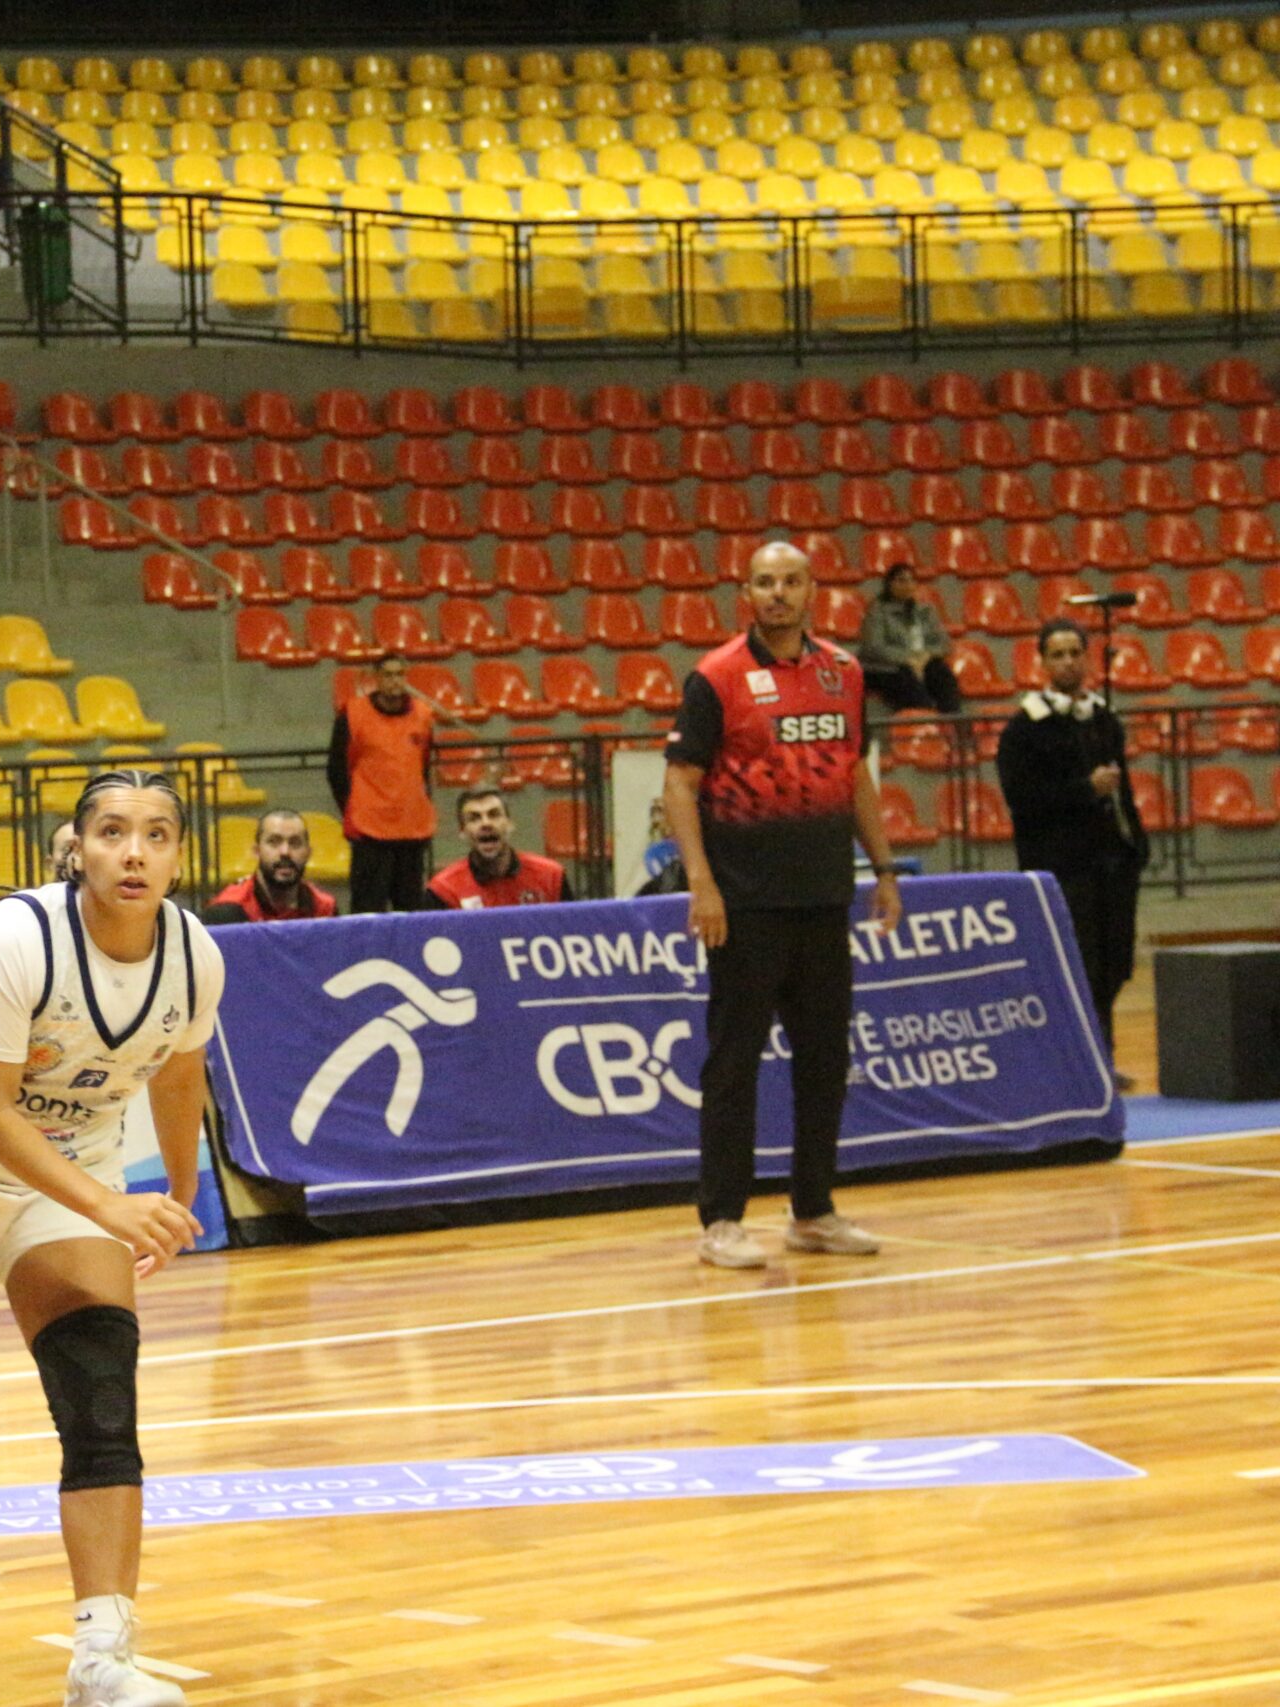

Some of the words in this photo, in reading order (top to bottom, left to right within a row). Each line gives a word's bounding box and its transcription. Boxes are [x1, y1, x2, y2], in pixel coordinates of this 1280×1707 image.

[780, 713, 846, 743] SESI
[501, 930, 708, 988] FORMAÇ
[884, 994, 1048, 1049] BRASILEIRO
[535, 1020, 704, 1117] CBC
[865, 1044, 998, 1091] CLUBES
[446, 1455, 678, 1484] CBC
[250, 1498, 336, 1513] DE
